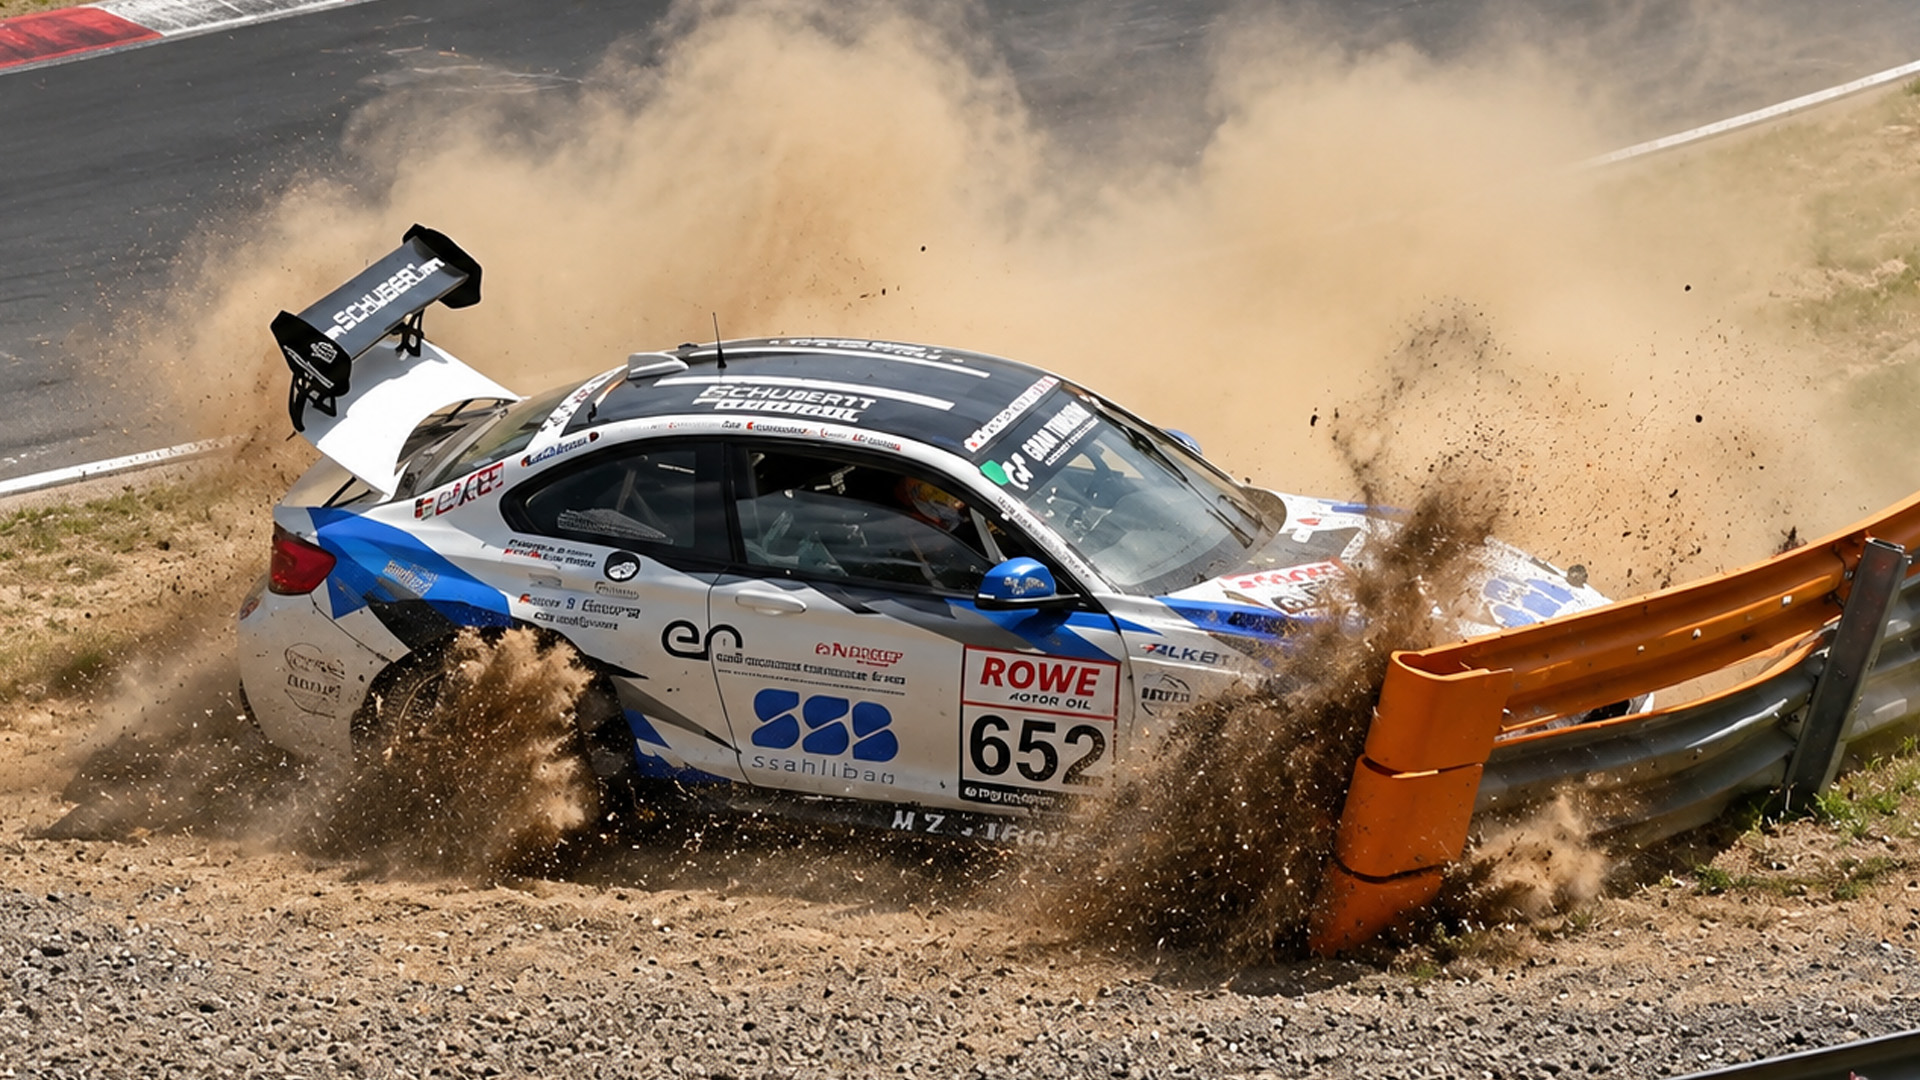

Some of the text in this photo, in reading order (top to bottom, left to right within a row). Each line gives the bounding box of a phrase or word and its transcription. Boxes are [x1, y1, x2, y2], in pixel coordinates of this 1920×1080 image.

[981, 657, 1100, 696] ROWE
[1065, 698, 1091, 710] OIL
[969, 714, 1107, 785] 652
